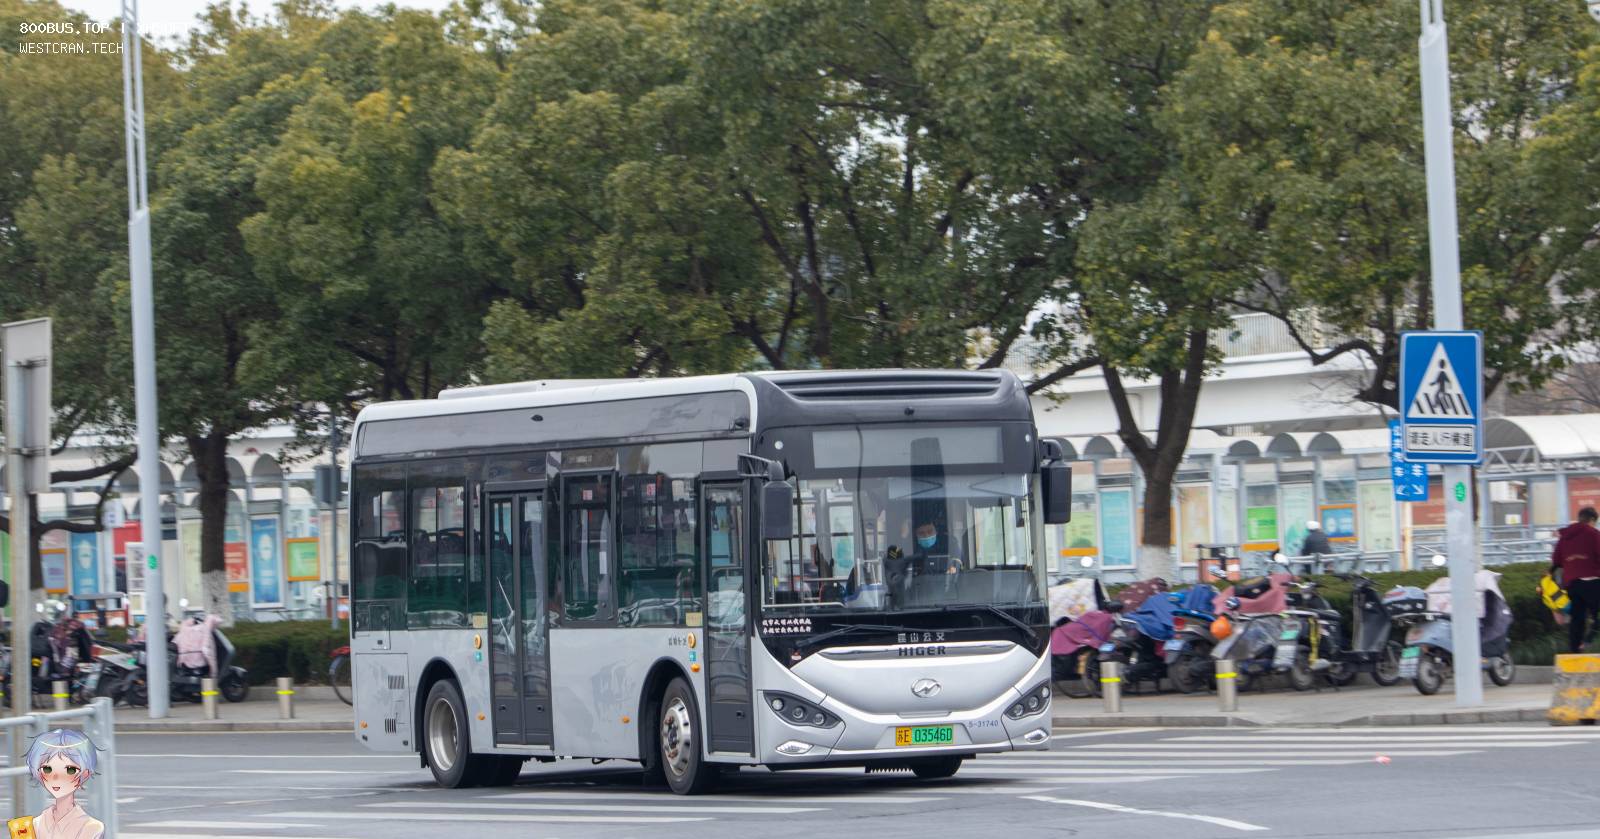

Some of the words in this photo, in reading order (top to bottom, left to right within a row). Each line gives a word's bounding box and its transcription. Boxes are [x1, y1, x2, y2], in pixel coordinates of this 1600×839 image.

[897, 632, 945, 643] 昆山公交
[898, 645, 946, 657] HIGER
[914, 727, 953, 743] 03546D
